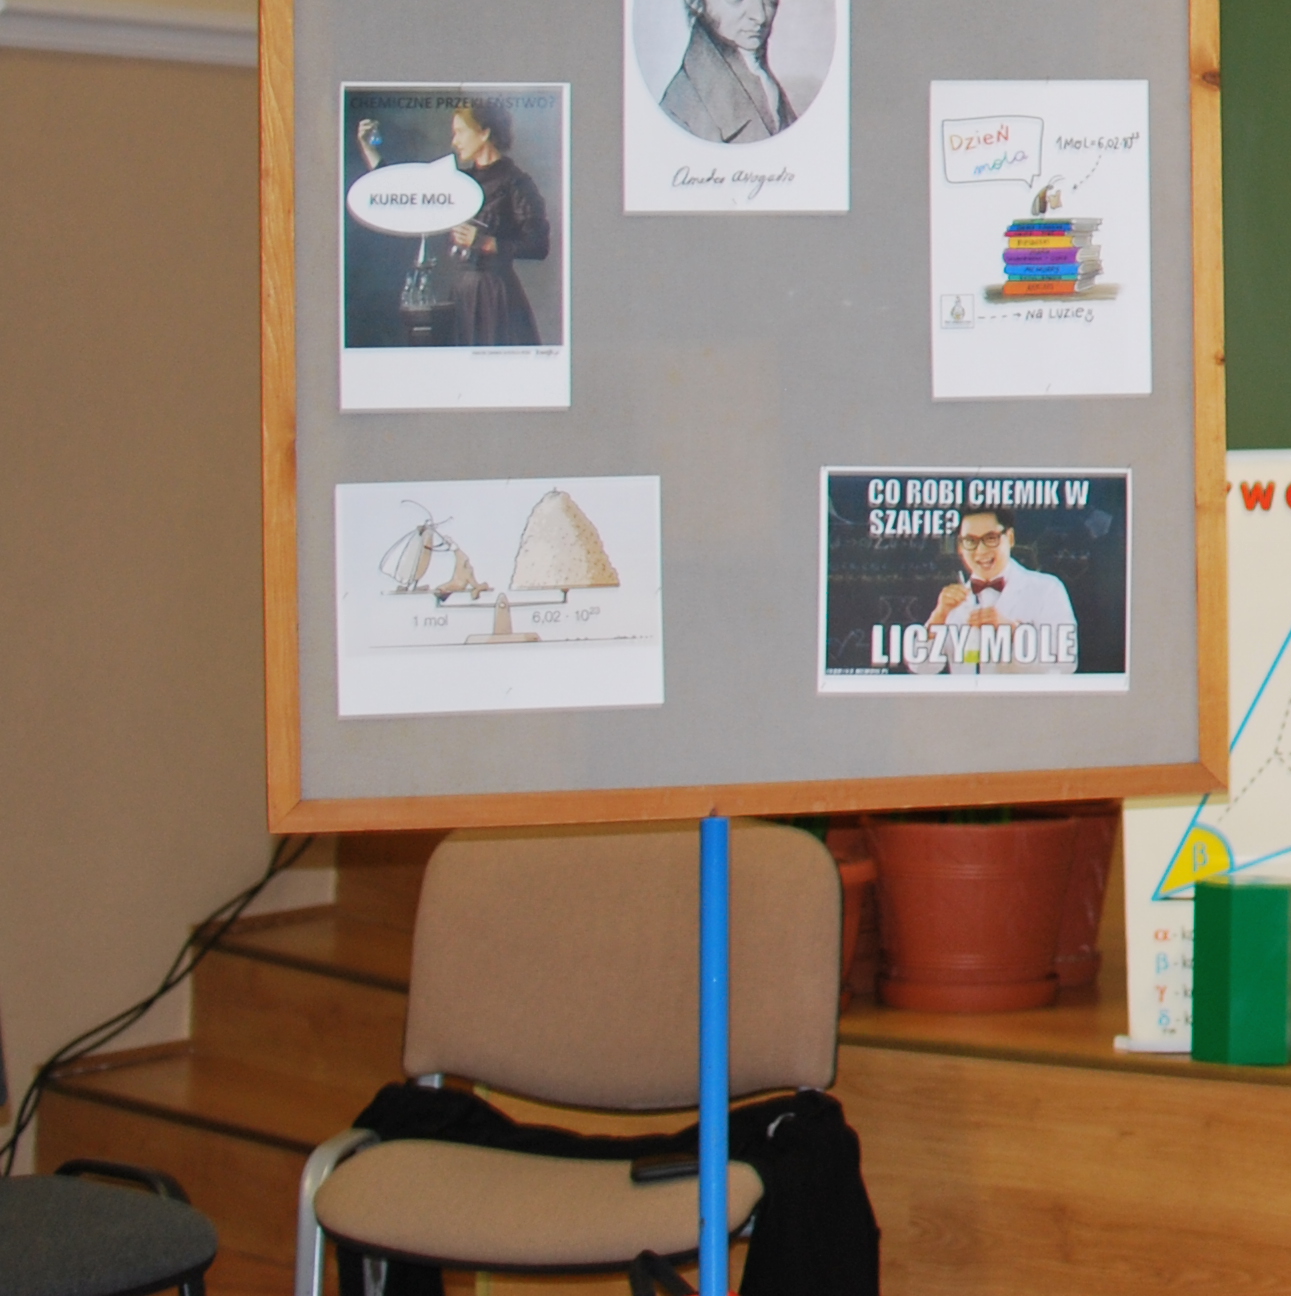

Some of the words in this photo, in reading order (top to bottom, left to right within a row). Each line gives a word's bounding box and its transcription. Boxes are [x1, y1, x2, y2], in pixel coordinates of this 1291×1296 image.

[369, 192, 418, 206] KURDE
[421, 192, 455, 206] MOL
[868, 478, 900, 506] CO
[906, 478, 963, 506] ROBI
[968, 479, 1060, 506] CHEMIK
[1064, 480, 1090, 506] W
[1240, 480, 1276, 511] W
[869, 509, 961, 536] SZAFIE?
[424, 614, 449, 628] mol
[532, 610, 561, 624] 6,02
[871, 622, 970, 665] LICZY
[980, 622, 1078, 665] MOLE
